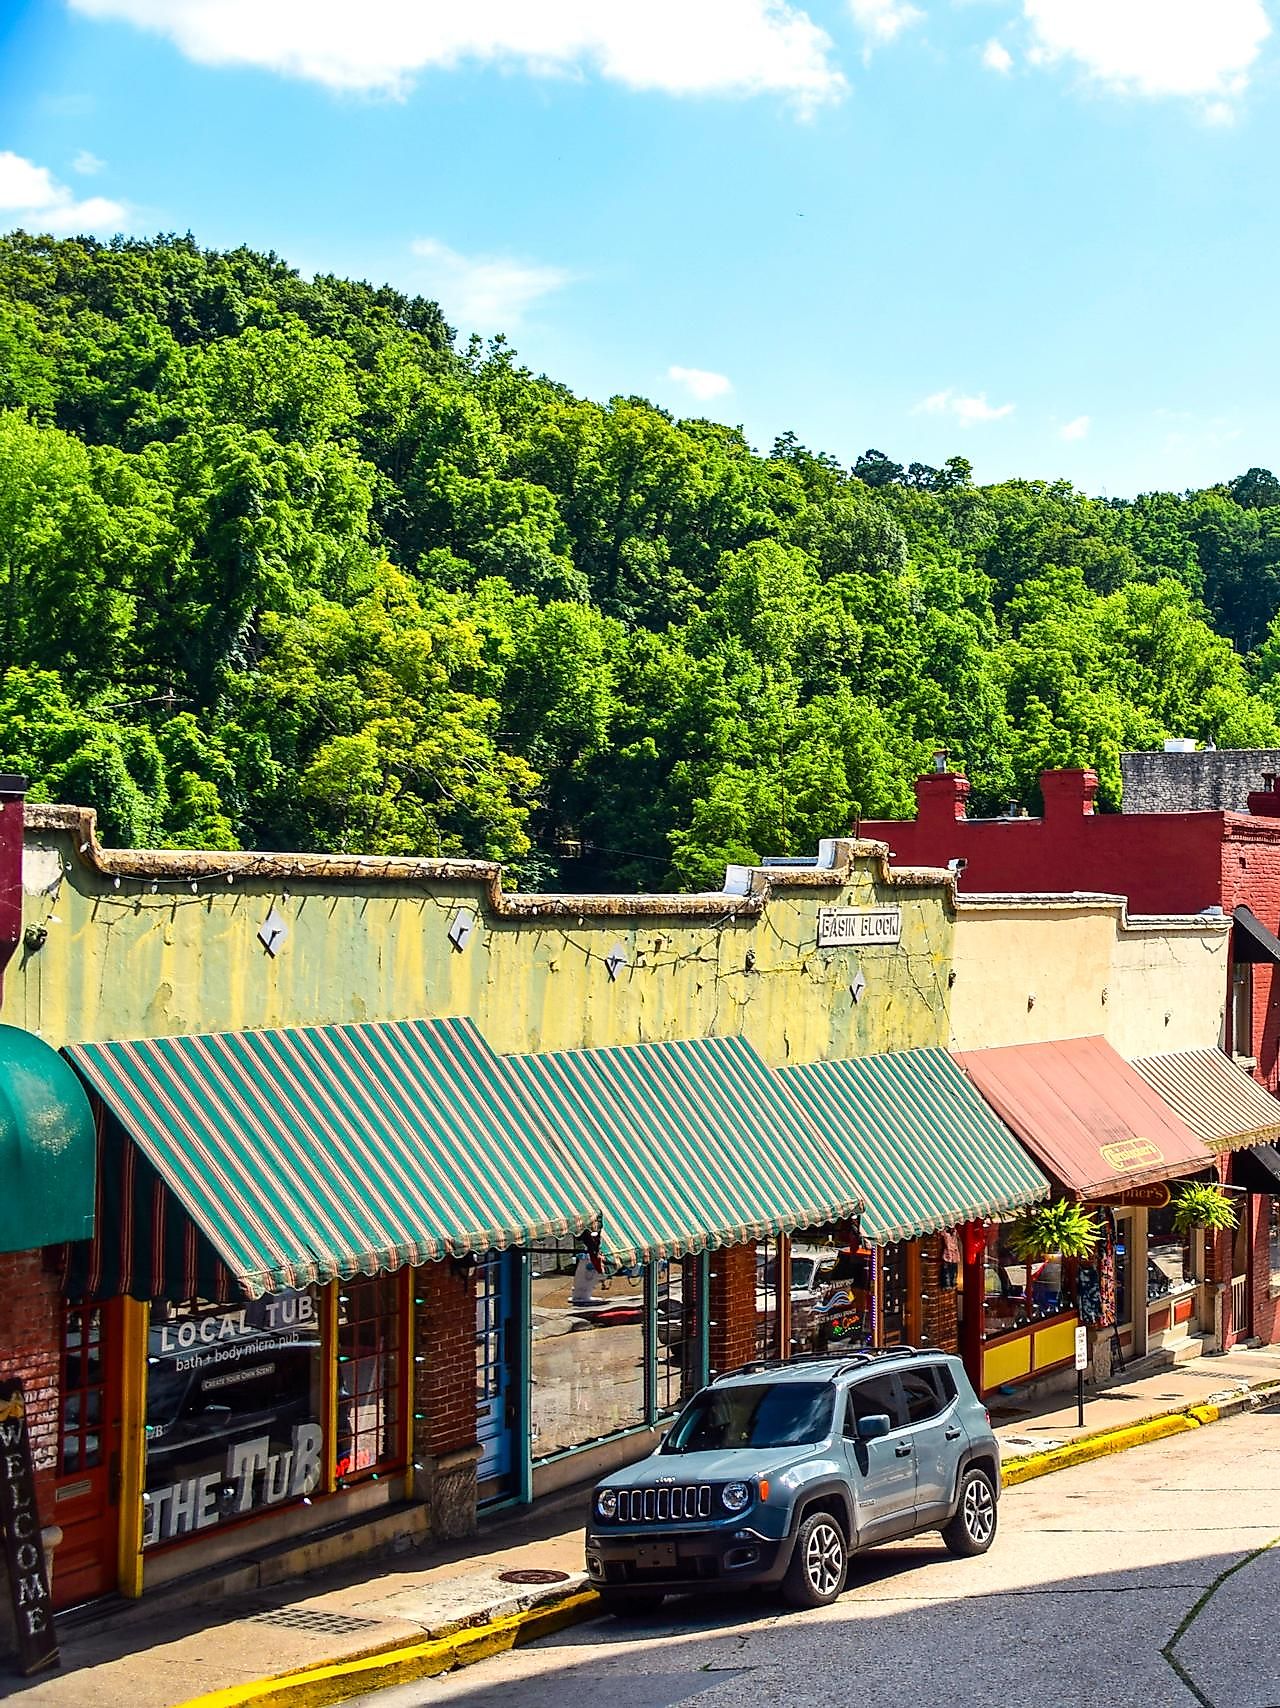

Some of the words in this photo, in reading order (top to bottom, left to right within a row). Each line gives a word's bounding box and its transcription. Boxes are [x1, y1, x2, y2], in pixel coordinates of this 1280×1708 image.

[822, 917, 856, 938] BASIN
[861, 916, 899, 937] BLOCK
[161, 1309, 252, 1352] LOCAL
[266, 1295, 313, 1328] TUB
[175, 1354, 203, 1372] bath
[215, 1345, 241, 1364] body
[244, 1338, 276, 1355] micro
[278, 1331, 300, 1350] pub
[0, 1421, 47, 1635] WELCOME
[147, 1471, 222, 1546] THE
